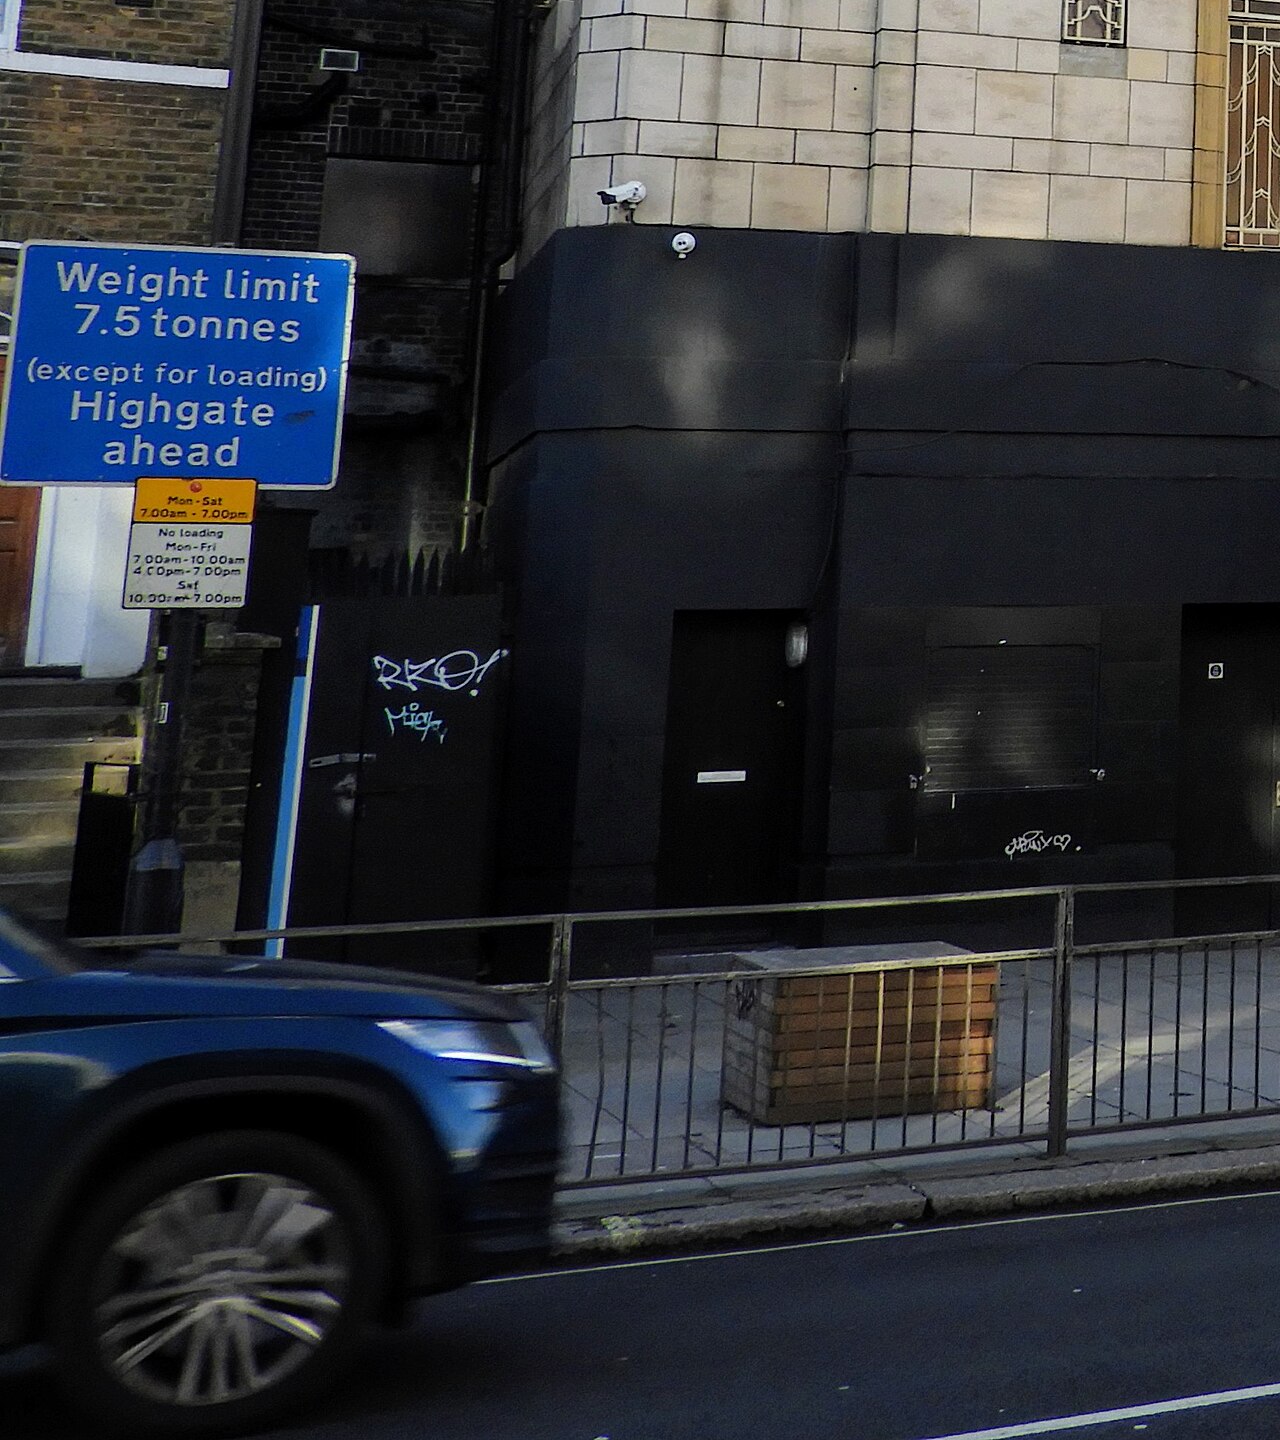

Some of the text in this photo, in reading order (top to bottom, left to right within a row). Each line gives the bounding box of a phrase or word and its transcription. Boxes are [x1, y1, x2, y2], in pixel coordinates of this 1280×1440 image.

[56, 261, 320, 304] Weight limit
[74, 303, 301, 343] 7.5 tonnes
[26, 357, 328, 393] (except for loading)
[69, 390, 275, 431] Highgate
[102, 433, 240, 468] ahead
[159, 528, 224, 538] No loading
